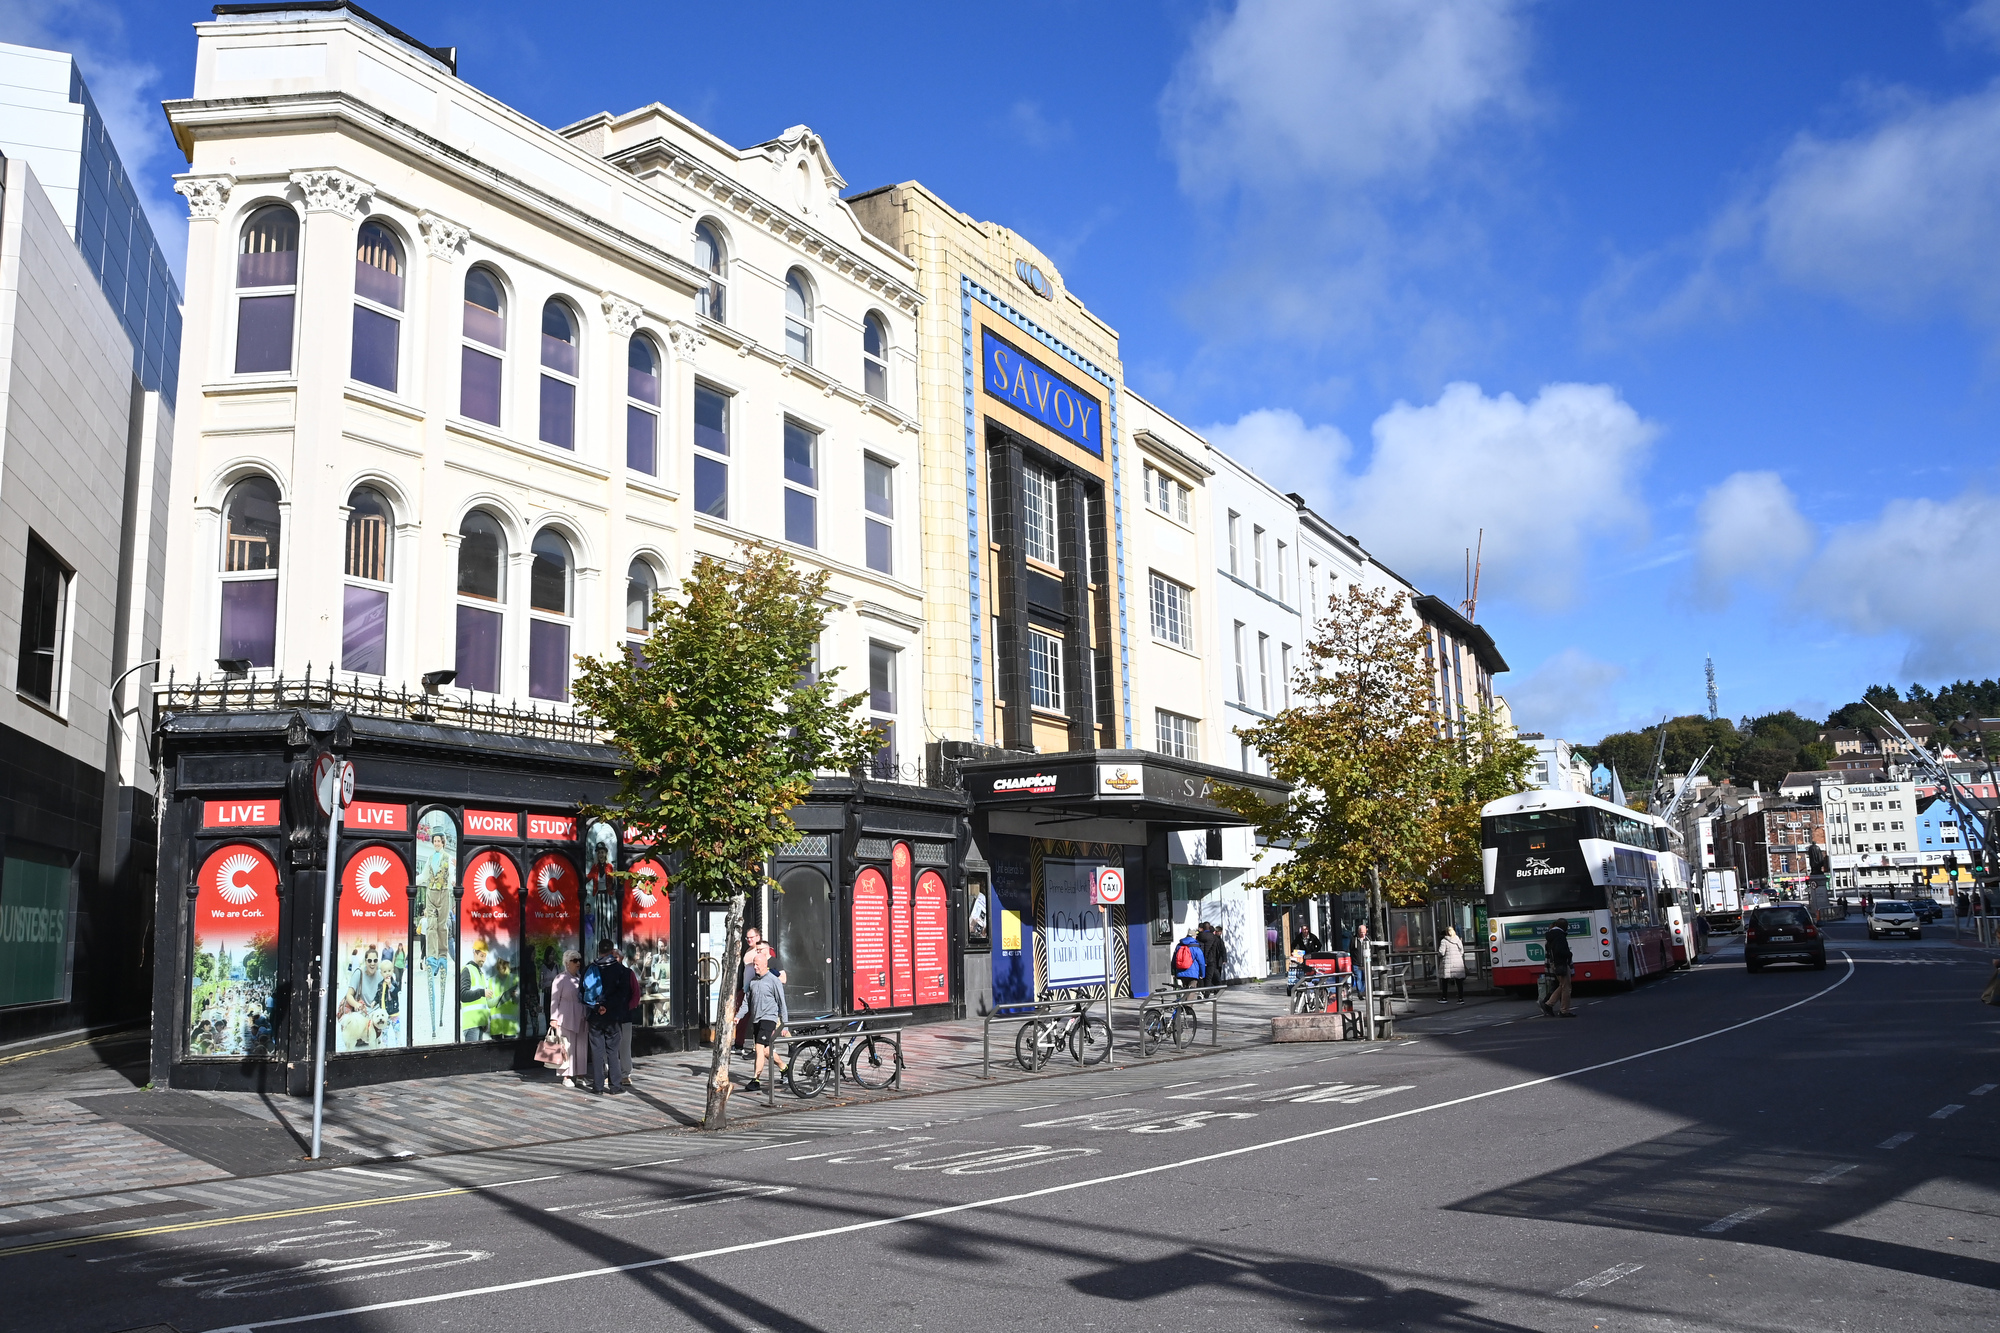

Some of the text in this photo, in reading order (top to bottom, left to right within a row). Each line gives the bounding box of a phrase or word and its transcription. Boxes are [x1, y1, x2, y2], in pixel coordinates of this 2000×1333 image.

[993, 349, 1093, 441] SAVOY
[218, 805, 266, 822] LIVE
[357, 808, 394, 824] LIVE
[468, 815, 513, 832] WORK
[530, 819, 573, 836] STUDY
[1516, 866, 1566, 878] Bus Éireann
[1102, 883, 1118, 892] TAXI
[211, 909, 225, 918] We
[241, 909, 265, 918] Cork.
[352, 908, 363, 917] We
[377, 909, 397, 917] Cork.
[1082, 945, 1103, 962] STREE
[1528, 948, 1543, 956] TFI
[1019, 1107, 1259, 1134] BUS
